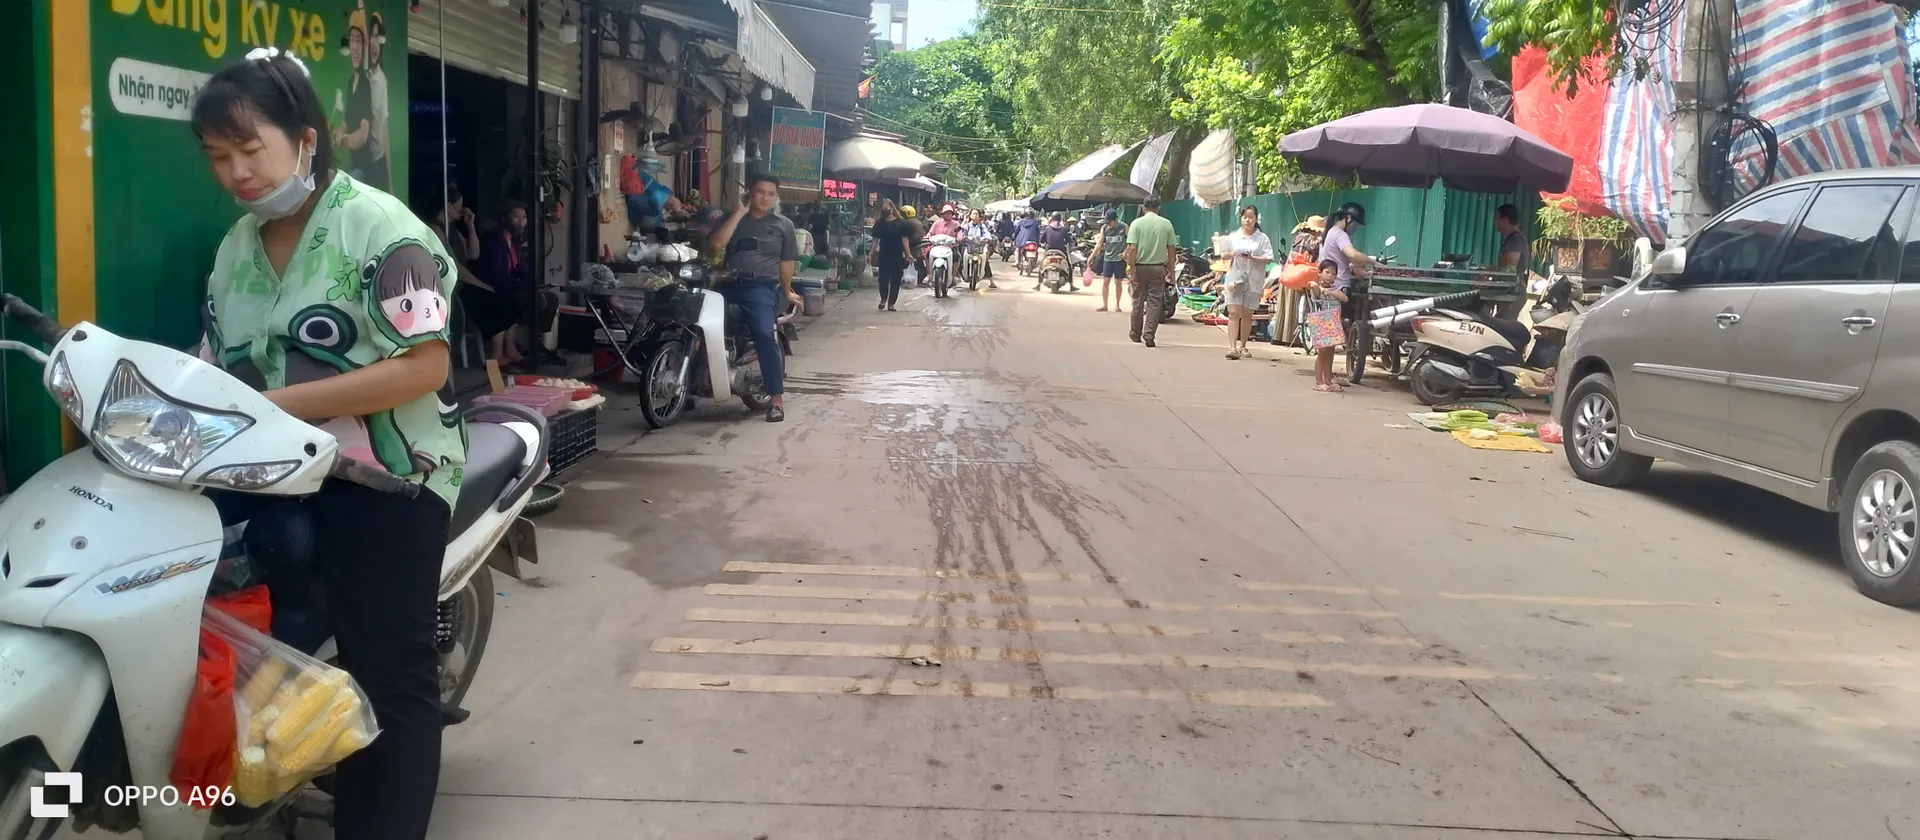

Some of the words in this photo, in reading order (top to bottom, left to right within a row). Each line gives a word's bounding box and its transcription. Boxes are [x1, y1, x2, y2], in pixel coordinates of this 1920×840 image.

[289, 8, 325, 61] xe
[118, 73, 154, 104] Nhận
[158, 84, 190, 109] ngay
[1460, 322, 1485, 334] EVN
[69, 485, 114, 512] HONDA
